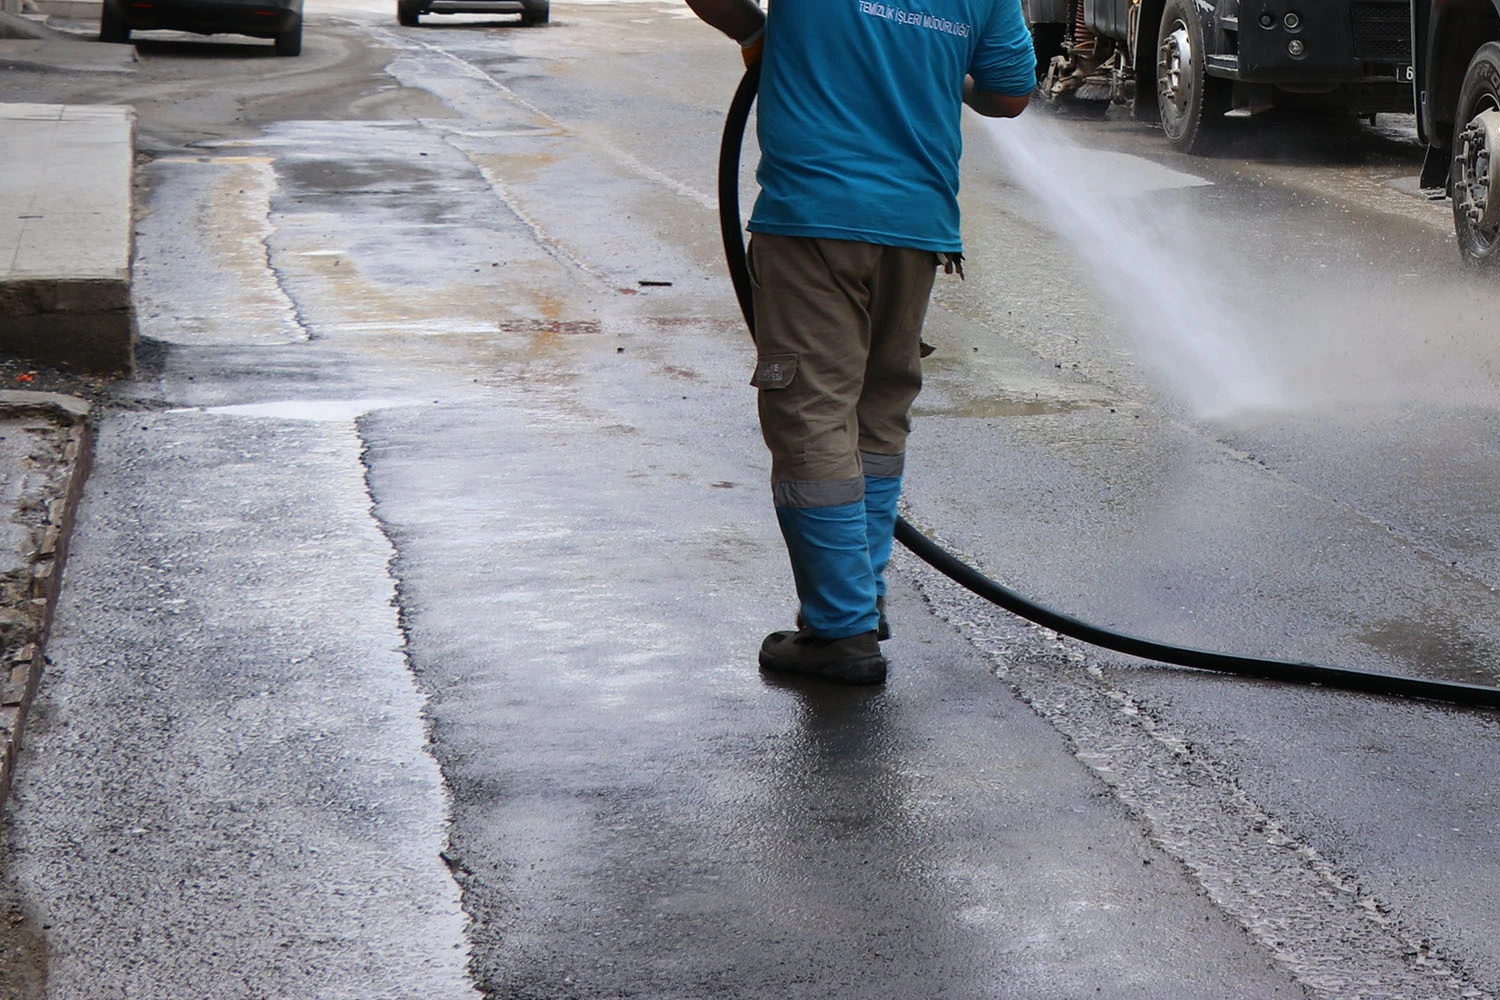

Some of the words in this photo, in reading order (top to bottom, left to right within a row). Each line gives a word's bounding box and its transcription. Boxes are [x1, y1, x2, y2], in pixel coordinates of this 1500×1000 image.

[859, 0, 894, 20] TEMİZLİK
[895, 7, 922, 25] İŞLERİ
[922, 13, 970, 38] MÜDÜRLÜĞÜ
